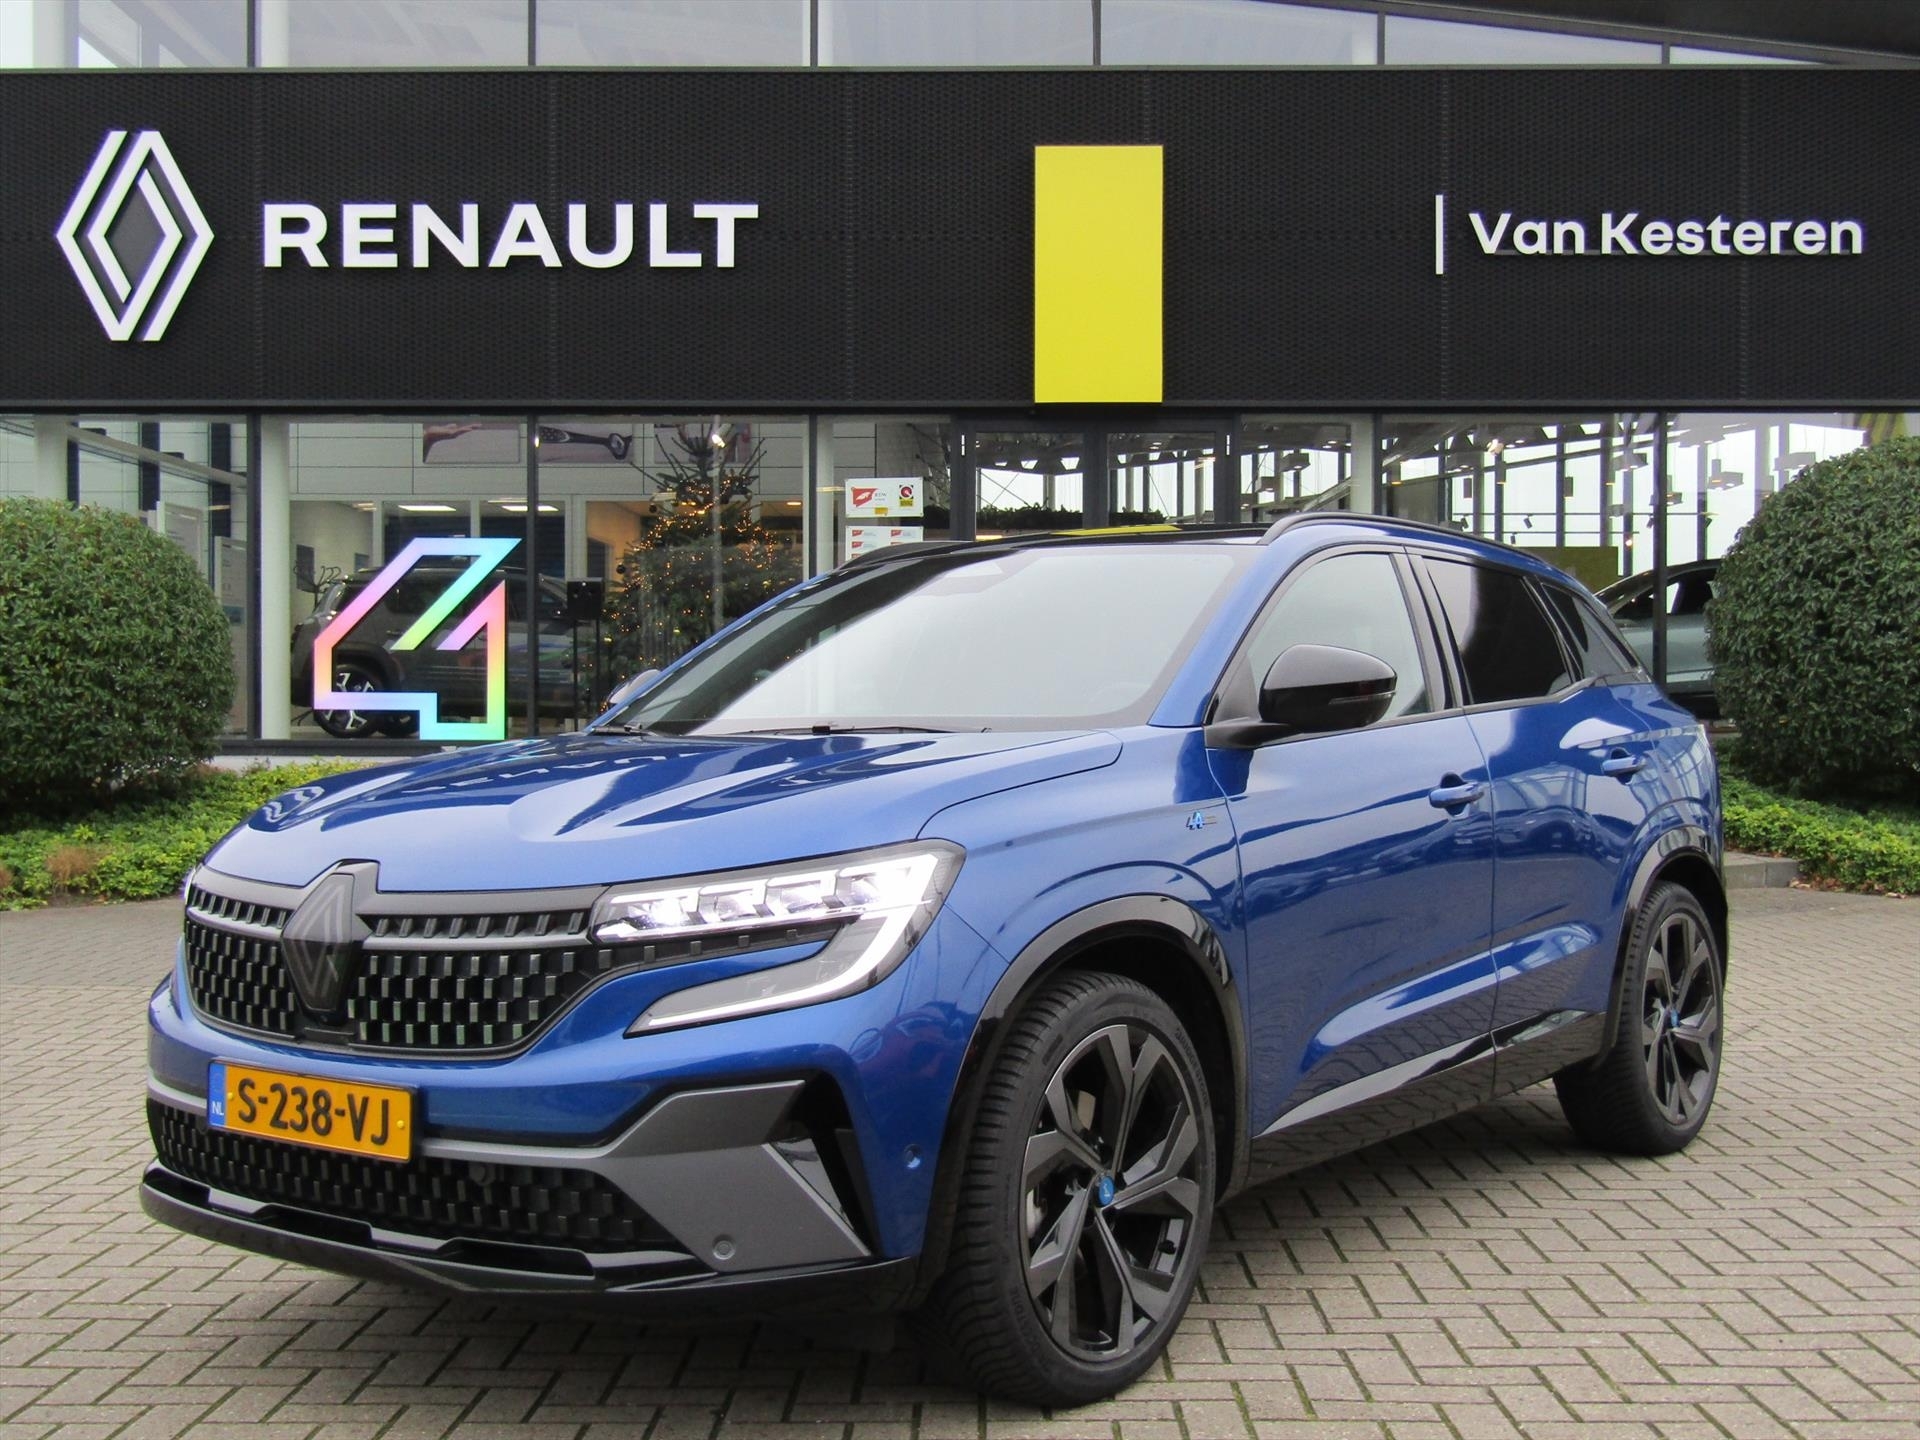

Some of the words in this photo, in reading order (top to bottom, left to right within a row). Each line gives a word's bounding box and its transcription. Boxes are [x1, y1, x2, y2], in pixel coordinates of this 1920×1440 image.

[263, 203, 759, 269] RENAULT
[1468, 212, 1586, 255] Van
[1601, 212, 1863, 255] Kesteren
[211, 1100, 225, 1116] NL
[238, 1077, 390, 1146] S-238-VJ
